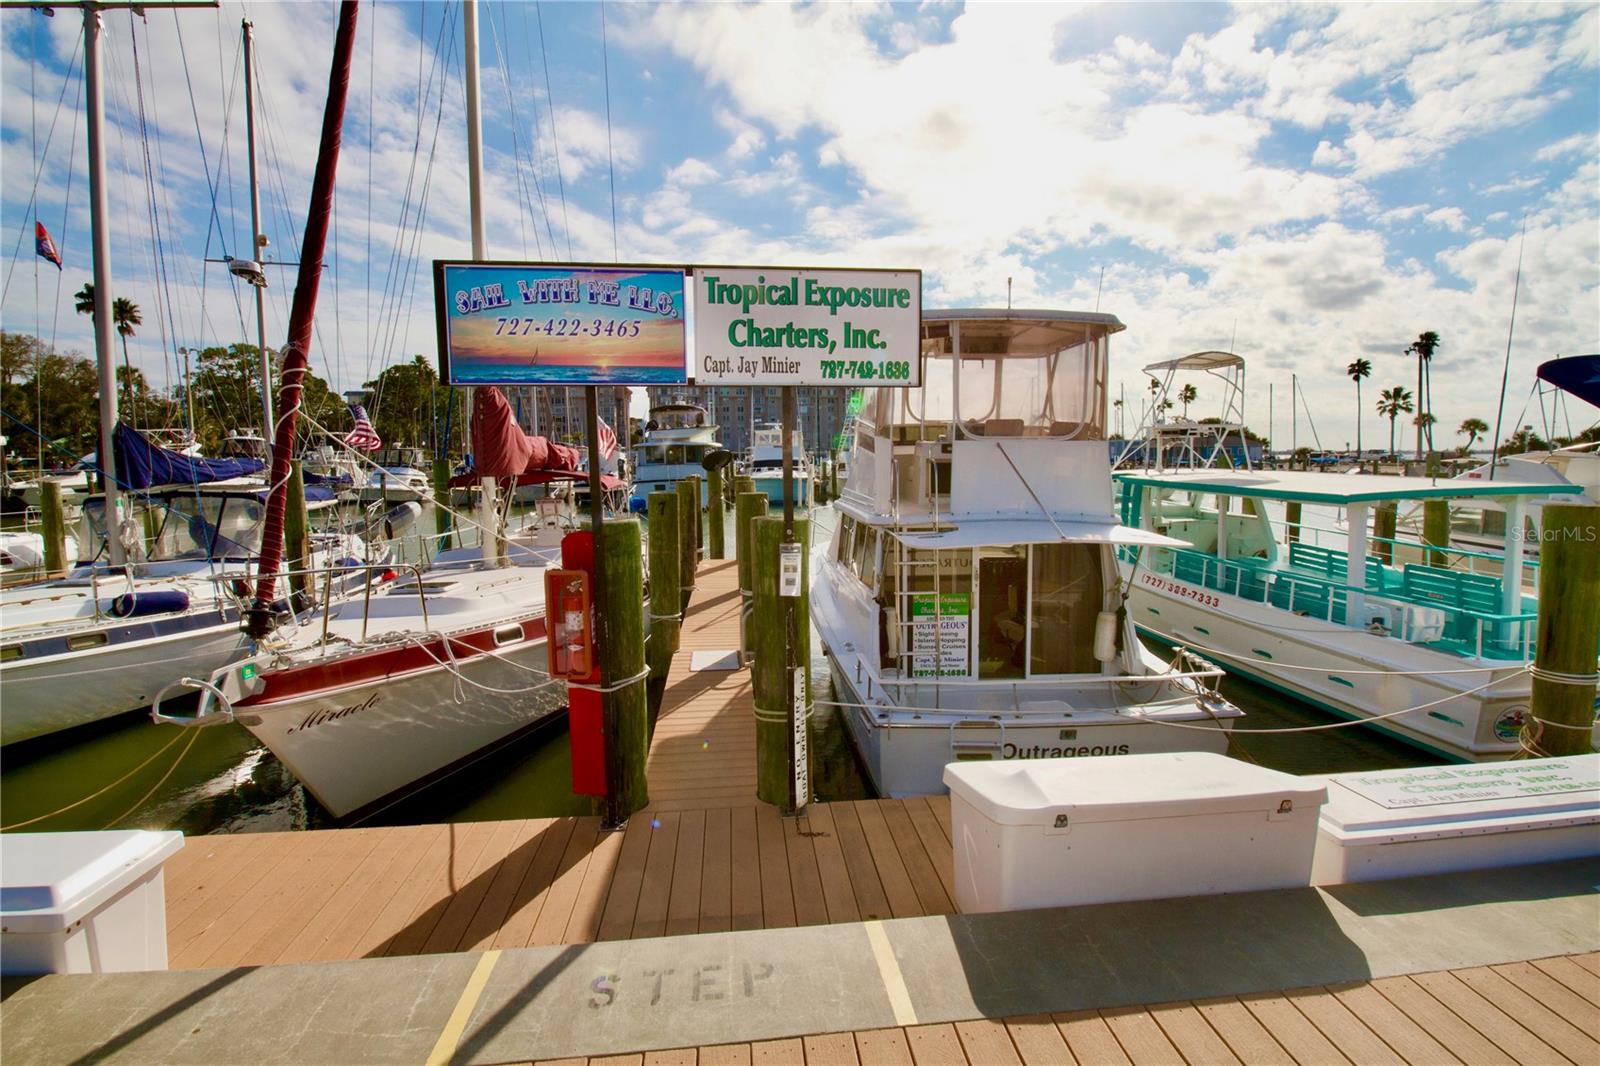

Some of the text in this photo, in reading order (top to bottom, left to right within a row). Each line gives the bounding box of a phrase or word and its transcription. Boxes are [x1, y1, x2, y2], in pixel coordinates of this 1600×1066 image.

[456, 283, 511, 313] SAIL
[517, 279, 580, 304] WITH
[587, 280, 621, 305] ME
[703, 276, 910, 315] Tropical Exposure
[495, 318, 641, 337] 727-422-3465
[728, 319, 887, 354] Charters, Inc.
[704, 355, 801, 378] Capt. Jay Minier
[1142, 574, 1166, 590] (727)
[287, 692, 380, 735] Miracle
[588, 963, 774, 1009] STEP
